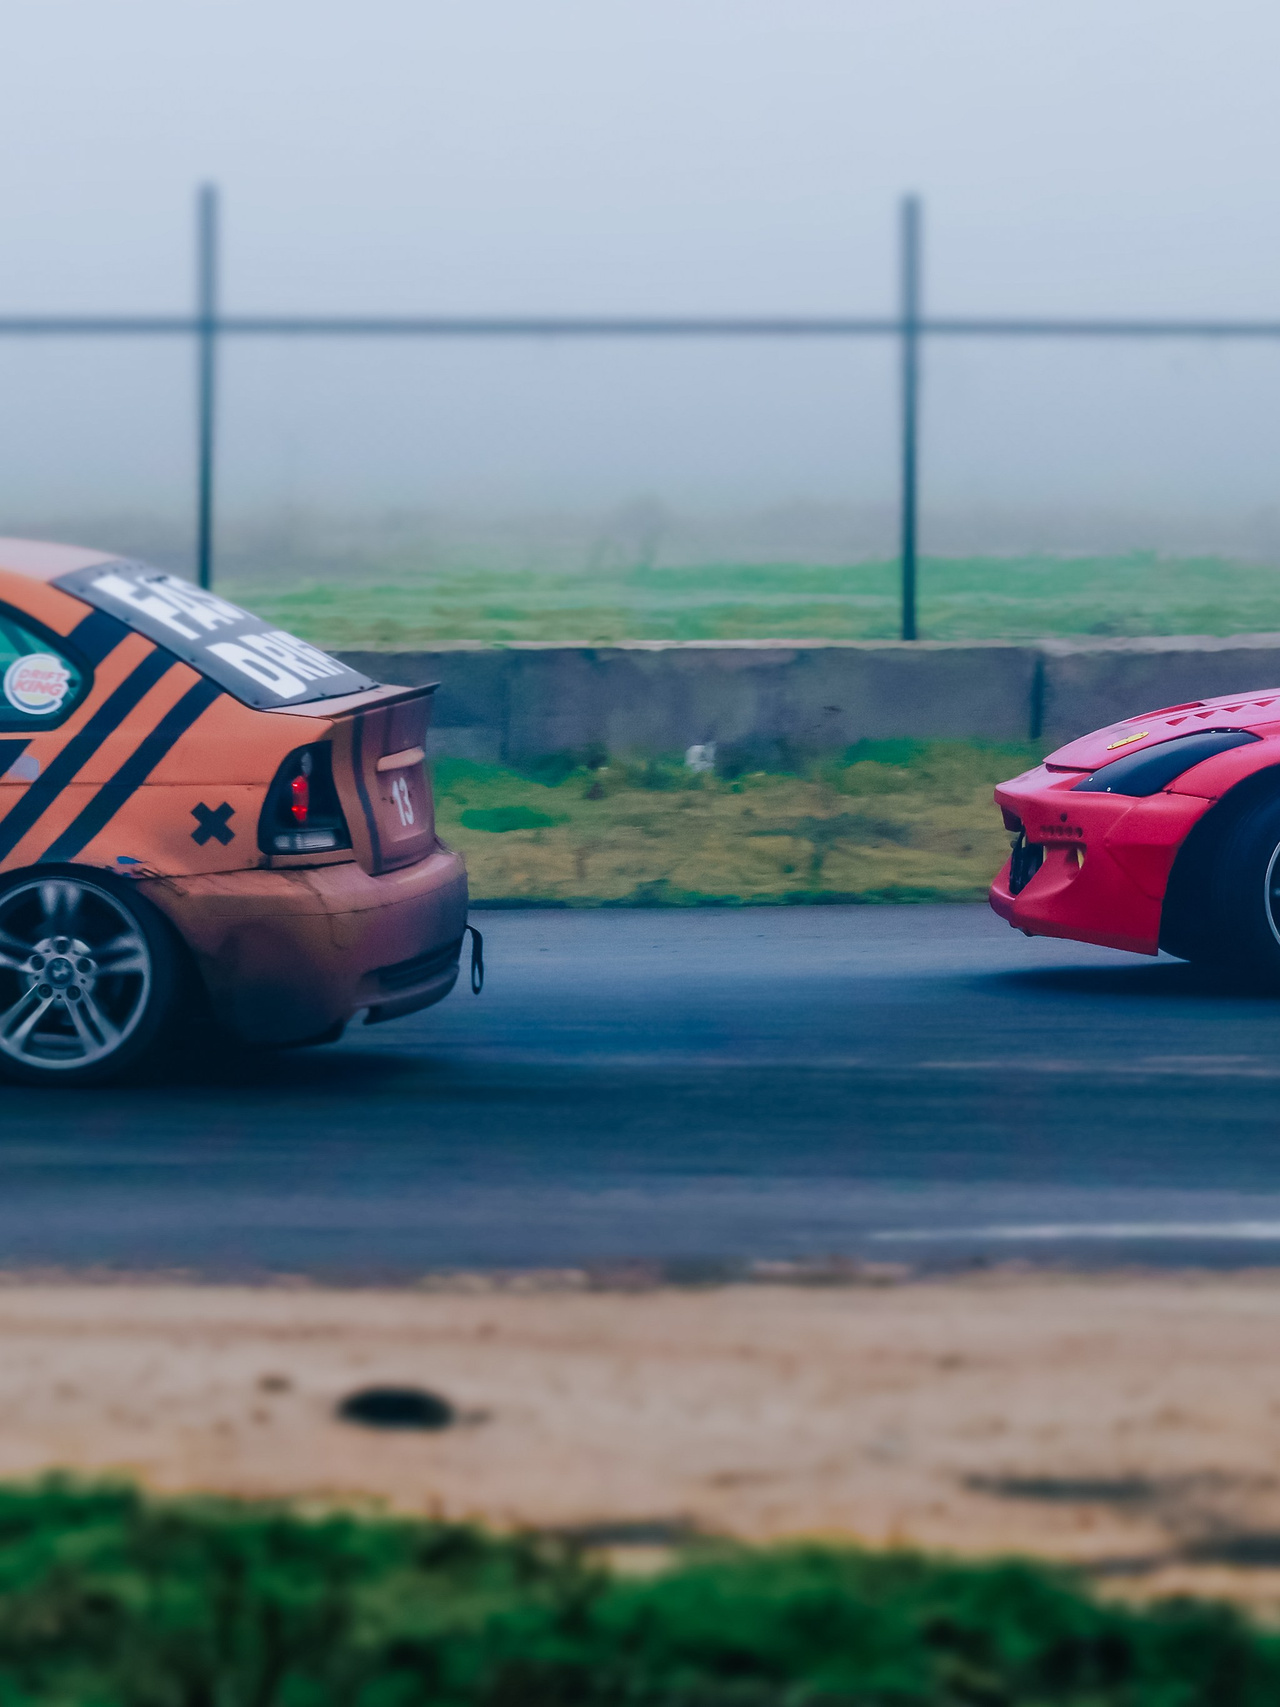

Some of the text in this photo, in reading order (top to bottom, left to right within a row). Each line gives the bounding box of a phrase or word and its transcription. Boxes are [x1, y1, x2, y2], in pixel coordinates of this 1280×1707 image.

[91, 574, 260, 640] FAS
[13, 680, 65, 696] KING
[19, 668, 67, 682] DRIFT
[205, 631, 359, 699] DRIF
[392, 777, 414, 827] 13
